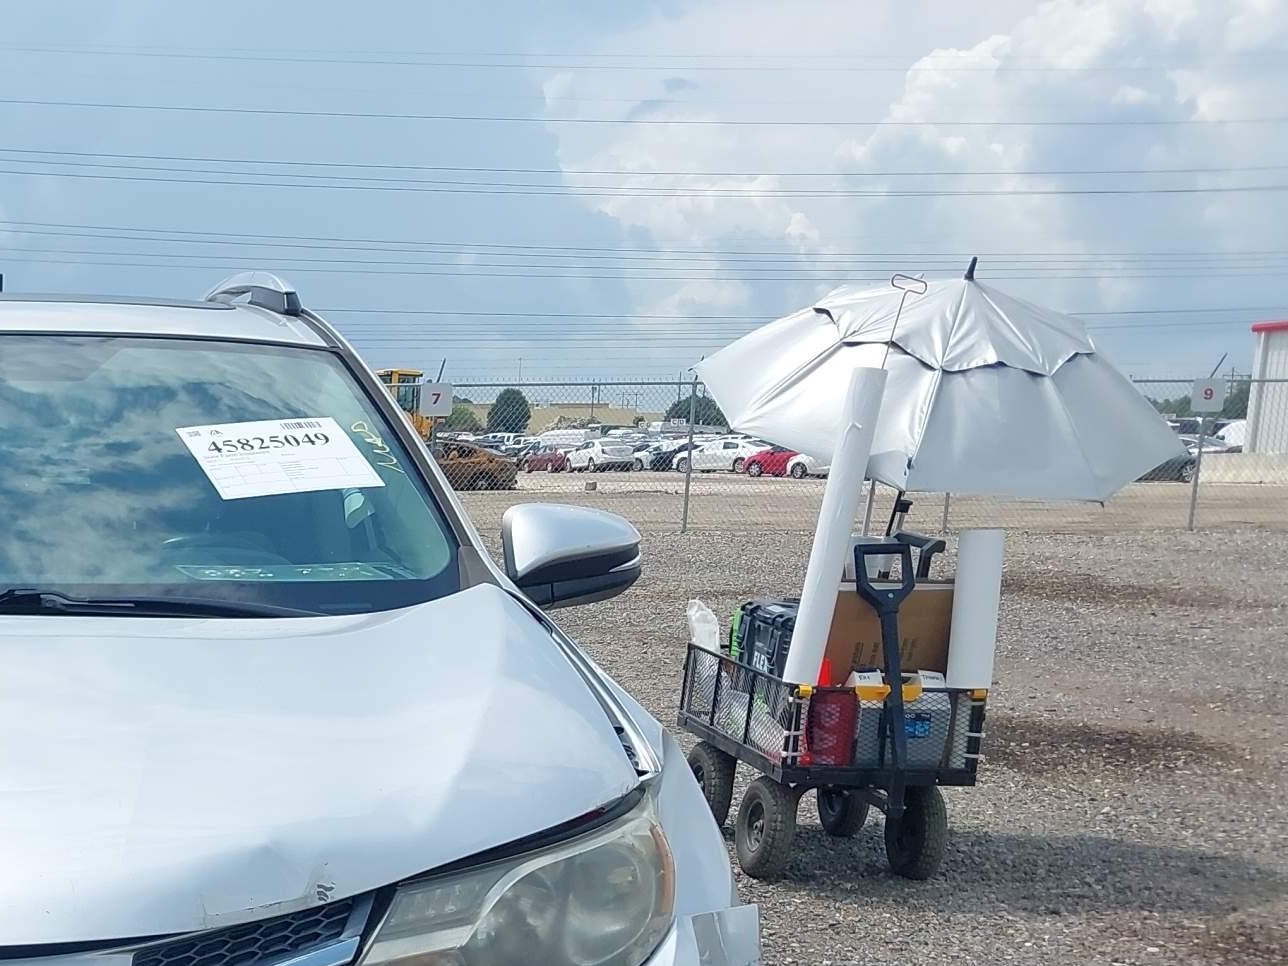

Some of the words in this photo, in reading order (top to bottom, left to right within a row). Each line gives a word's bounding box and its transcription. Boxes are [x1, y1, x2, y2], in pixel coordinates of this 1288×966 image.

[431, 392, 441, 405] 7
[1203, 387, 1214, 400] 9
[207, 432, 330, 454] 45825049
